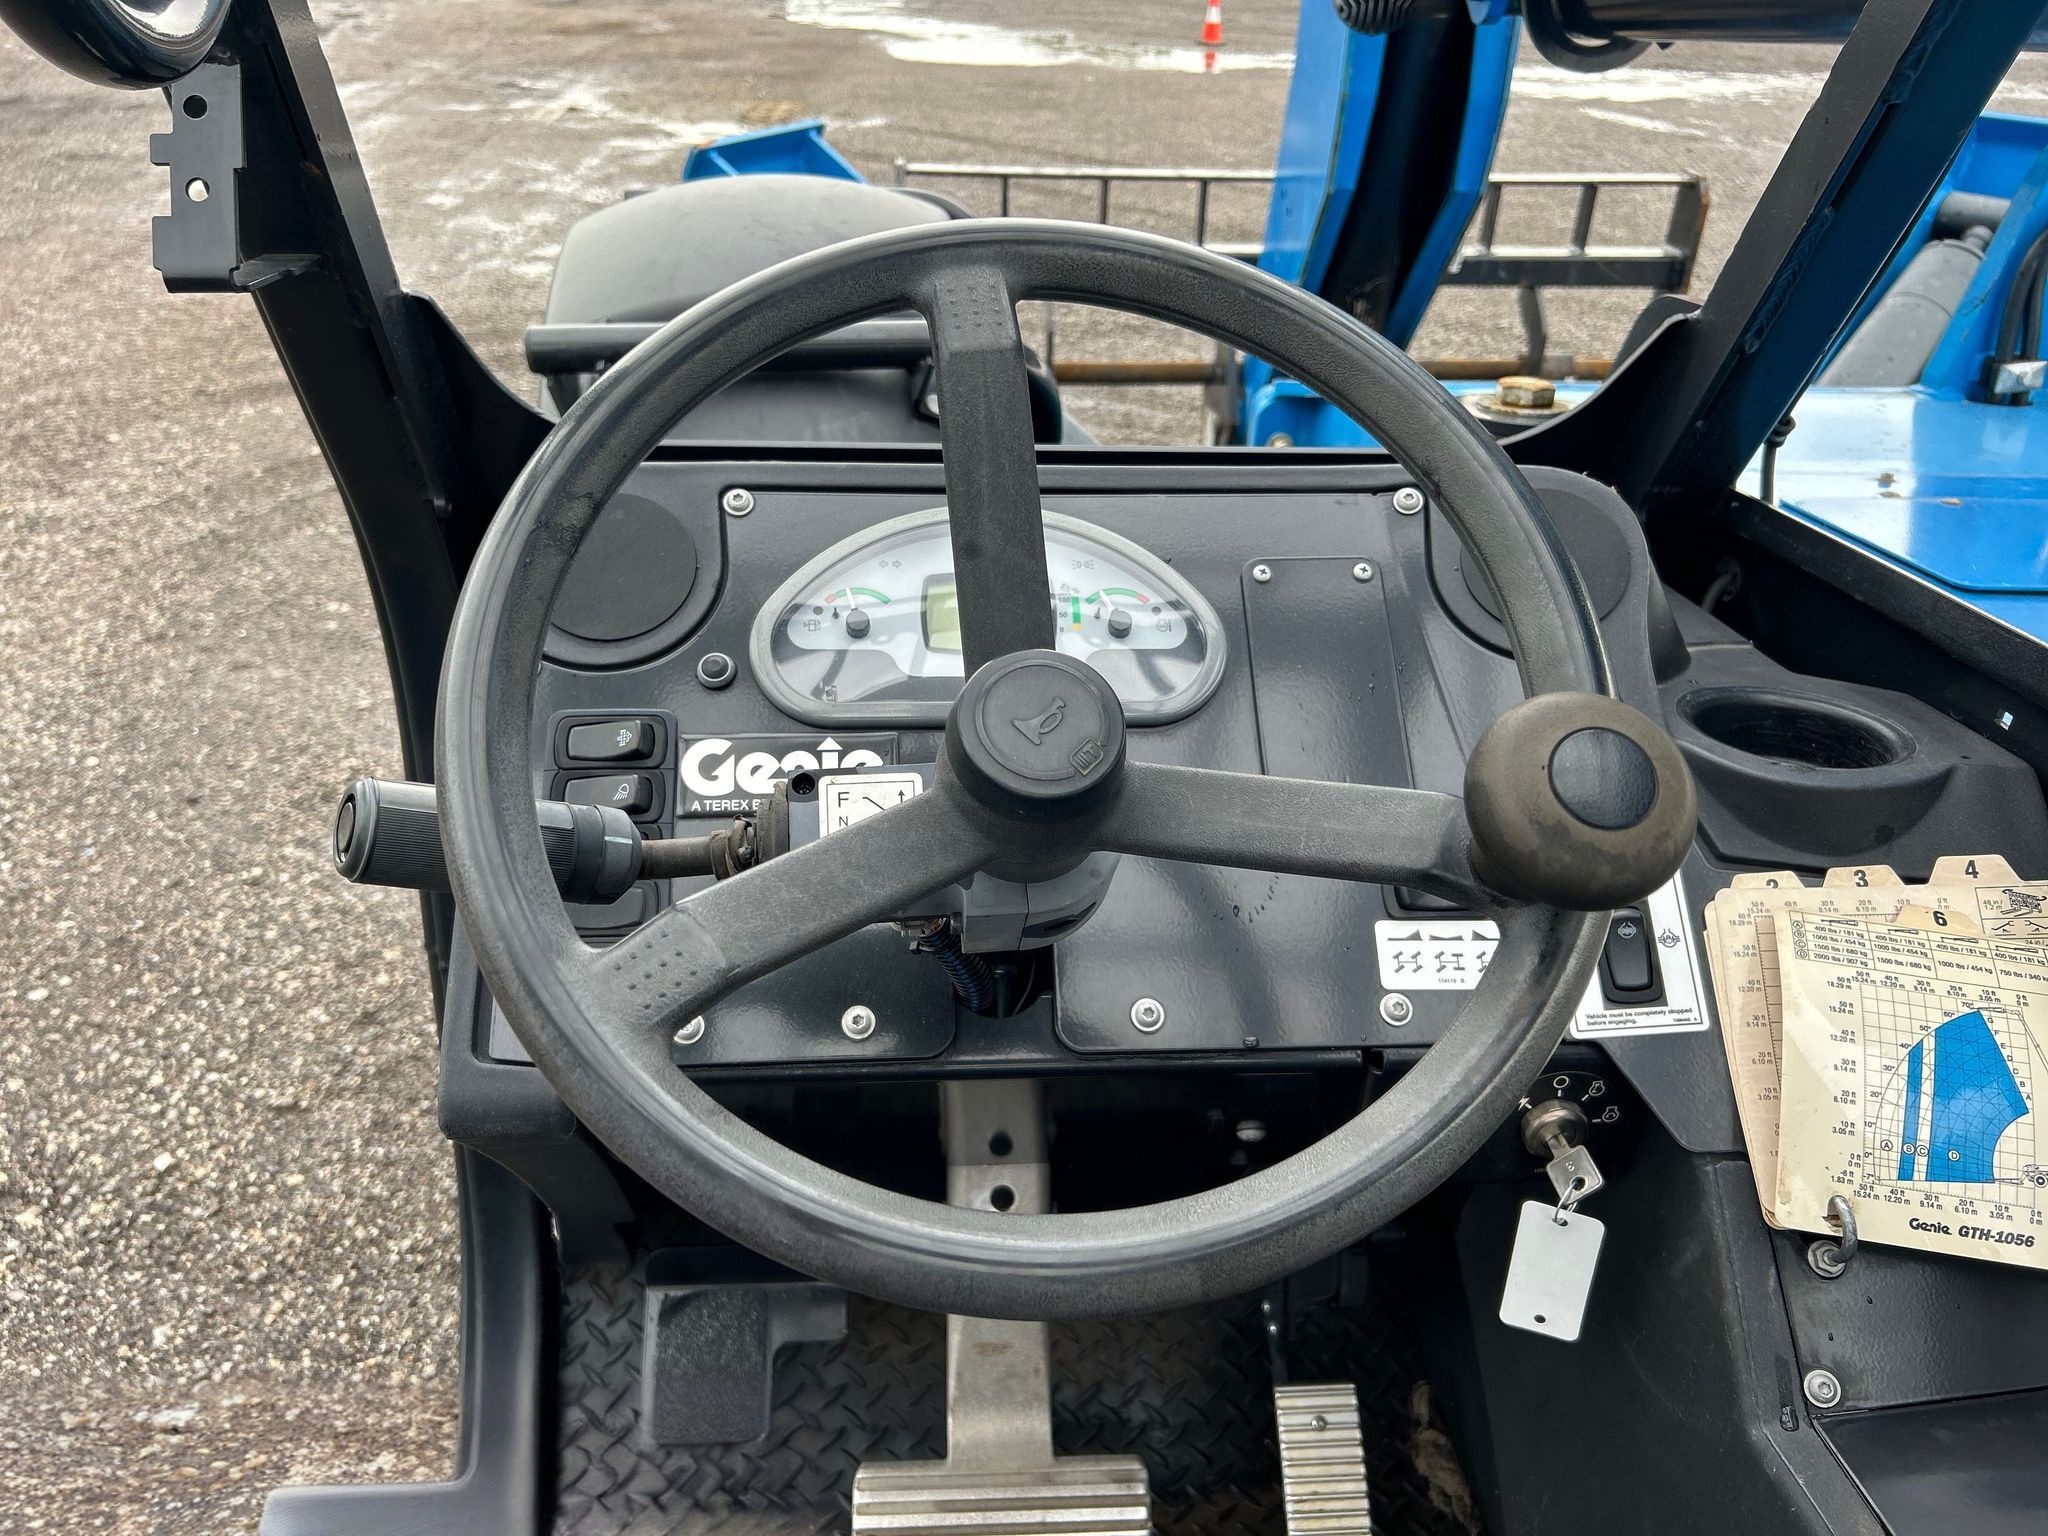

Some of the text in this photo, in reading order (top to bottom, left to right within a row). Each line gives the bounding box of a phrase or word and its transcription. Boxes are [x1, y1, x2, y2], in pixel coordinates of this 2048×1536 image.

[838, 791, 849, 807] F
[691, 800, 702, 811] A
[703, 799, 750, 811] TEREX
[839, 816, 849, 827] N
[1965, 860, 1979, 878] 4
[1854, 870, 1869, 887] 3
[1933, 911, 1947, 926] 6
[1827, 981, 1844, 989] 18.29
[1880, 980, 1897, 988] 12.20
[1829, 1006, 1846, 1014] 15.24
[1830, 1034, 1847, 1042] 12.20
[1834, 1064, 1847, 1072] 9.14
[1834, 1096, 1848, 1104] 6.10
[1832, 1127, 1846, 1135] 3.05
[1831, 1176, 1845, 1184] 1.83
[1853, 1190, 1871, 1199] 15.24
[1884, 1195, 1902, 1204] 12.20
[1920, 1201, 1934, 1209] 9.14
[1955, 1206, 1970, 1214] 6.10
[1990, 1211, 2004, 1220] 3.05
[1909, 1217, 2035, 1248] Genie GTH-1056
